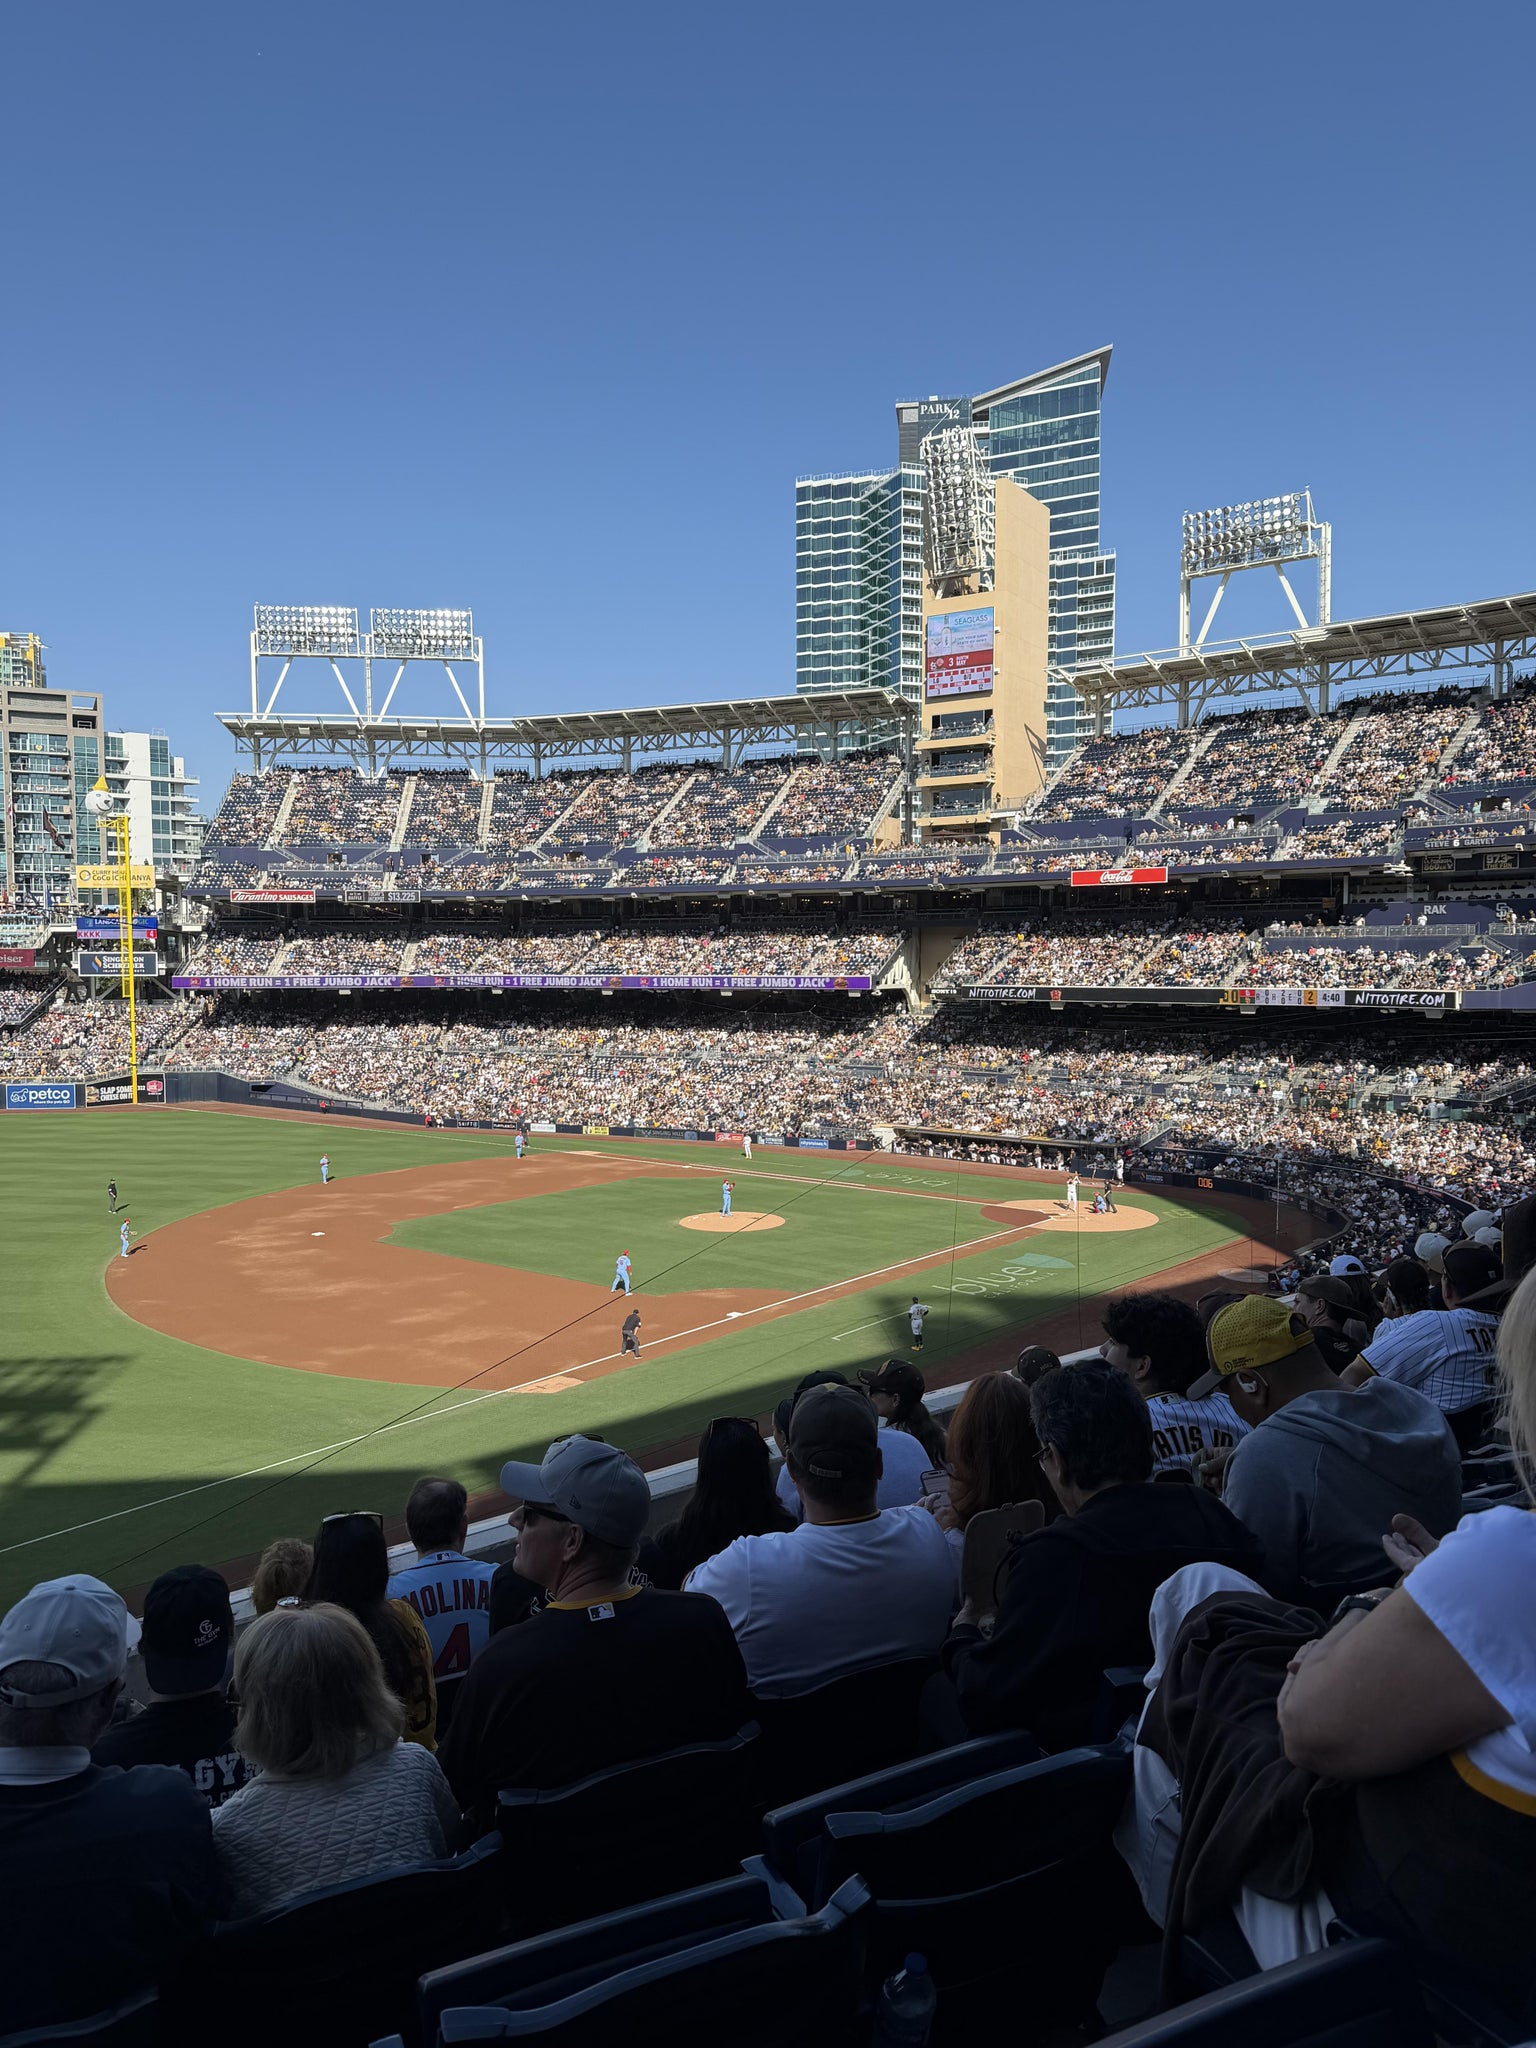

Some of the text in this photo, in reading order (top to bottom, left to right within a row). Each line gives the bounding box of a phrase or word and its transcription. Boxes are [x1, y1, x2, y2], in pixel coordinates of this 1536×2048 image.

[920, 403, 951, 414] PARK
[948, 410, 960, 419] 12
[954, 615, 988, 625] SEAGLASS
[949, 658, 954, 666] 3
[234, 891, 277, 901] Tarantino
[1424, 905, 1447, 914] RAK
[205, 977, 211, 986] 1
[214, 977, 247, 986] HOME
[250, 977, 272, 986] RUN
[285, 977, 290, 986] 1
[294, 977, 320, 986] FREE
[322, 977, 361, 986] JUMBO
[450, 977, 454, 986] 1
[457, 977, 483, 986] HOME
[485, 977, 504, 986] RUN
[513, 977, 517, 986] 1
[520, 977, 542, 986] FREE
[544, 977, 577, 986] JUMBO
[652, 977, 658, 987] 1
[660, 977, 689, 987] HOME
[692, 977, 712, 987] RUN
[723, 977, 728, 987] 1
[731, 977, 756, 987] FREE
[759, 977, 796, 987] JUMBO
[969, 987, 1036, 999] NITTOTIRE.COM
[1308, 992, 1313, 1001] 2
[1322, 993, 1340, 1002] 4:40
[1356, 992, 1445, 1007] NITTOTIRE.COM
[29, 1089, 70, 1101] petco
[100, 1086, 115, 1095] SLAP
[100, 1093, 119, 1101] CHEESE
[932, 1266, 1037, 1295] blue
[984, 1271, 1058, 1299] CALIFORNIA
[433, 1623, 470, 1678] 4
